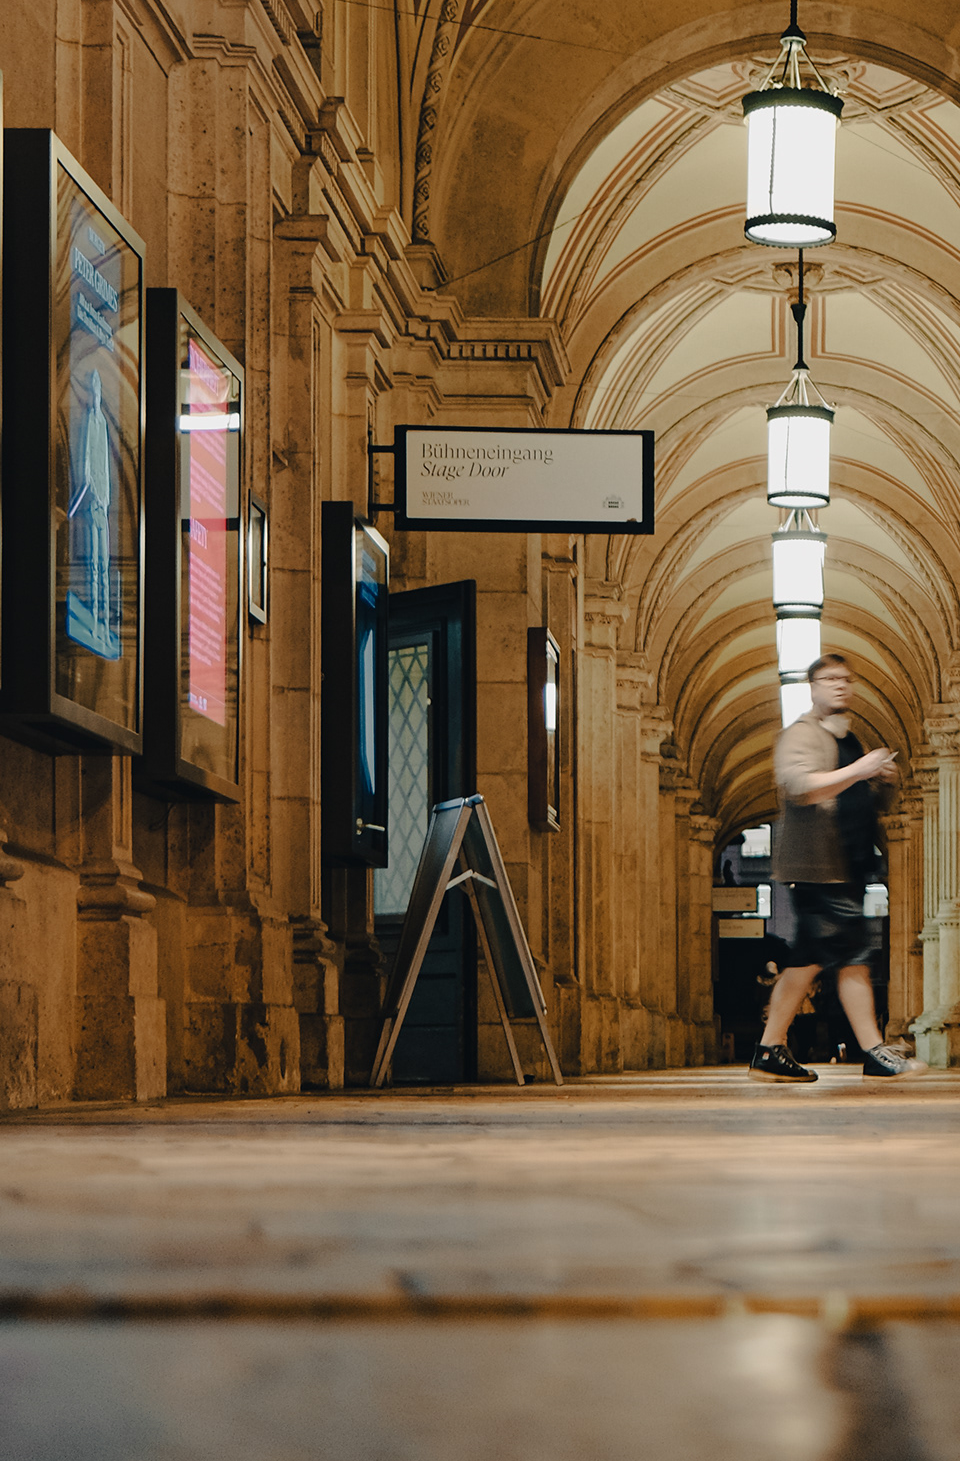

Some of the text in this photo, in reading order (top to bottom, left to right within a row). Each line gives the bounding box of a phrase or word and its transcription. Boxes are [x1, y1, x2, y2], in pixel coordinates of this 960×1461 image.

[74, 247, 95, 288] PETER
[95, 271, 118, 313] GRIMES
[422, 443, 554, 465] Bühneneingang
[420, 460, 510, 481] Stage Door
[422, 491, 454, 499] WIENER
